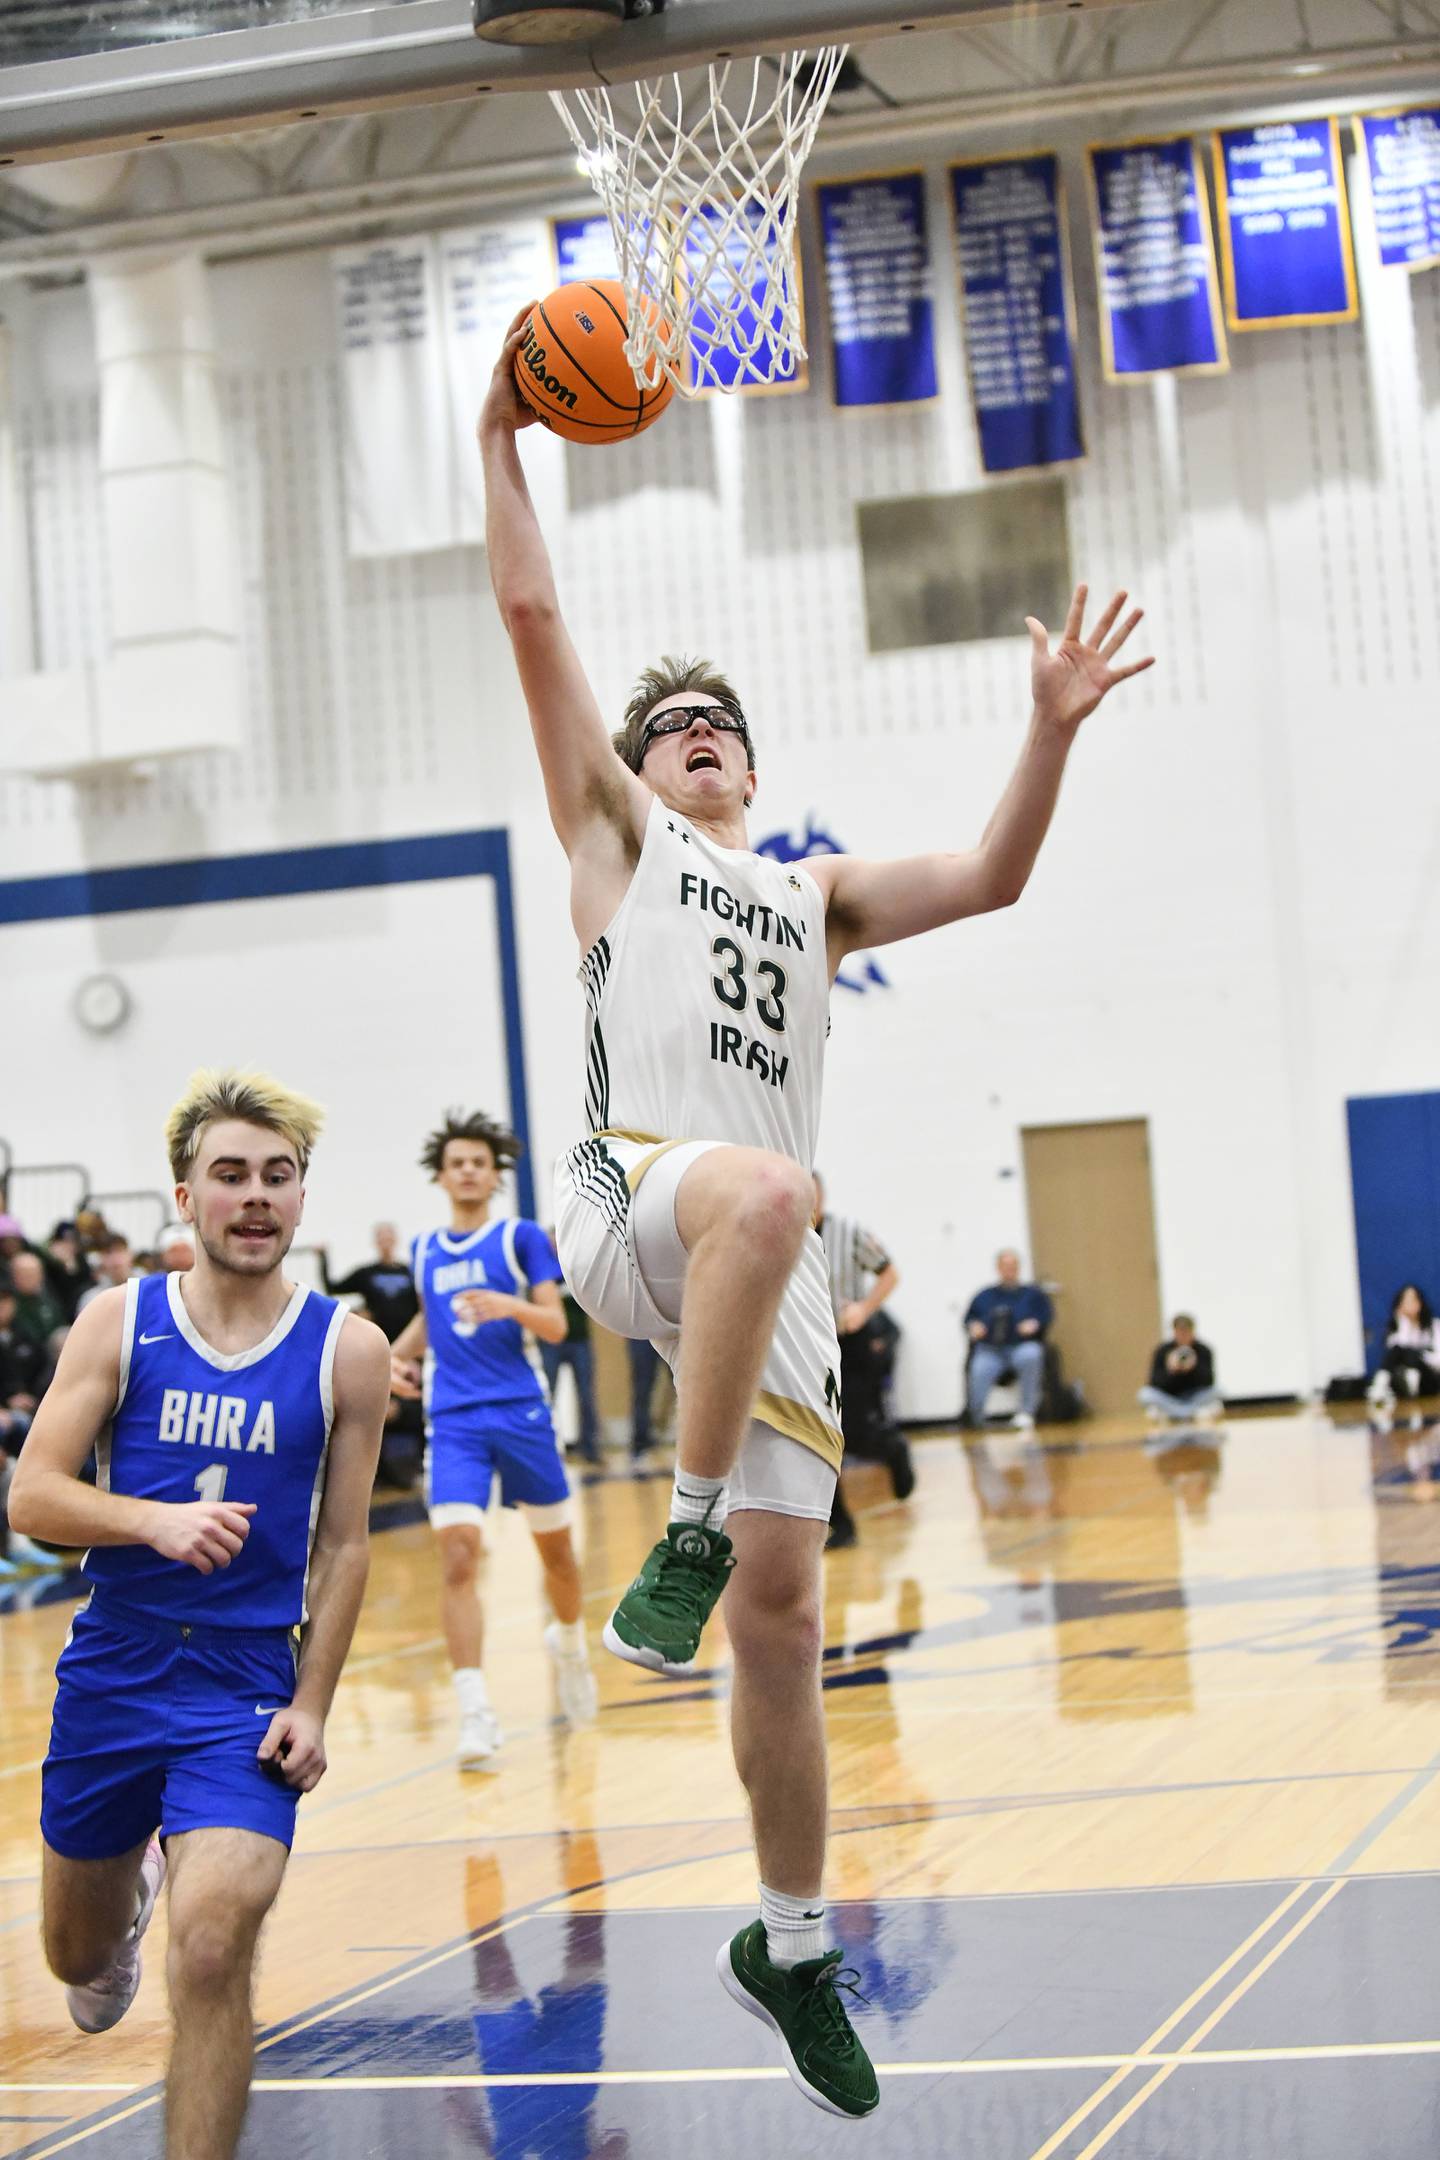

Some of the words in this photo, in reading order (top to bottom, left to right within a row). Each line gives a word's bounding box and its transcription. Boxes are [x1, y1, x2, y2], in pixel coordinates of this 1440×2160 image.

[680, 871, 808, 952] FIGHTIN'
[710, 934, 789, 1035] 33
[710, 1021, 789, 1092] IRISH
[158, 1388, 276, 1455] BHRA
[193, 1463, 229, 1502] 1
